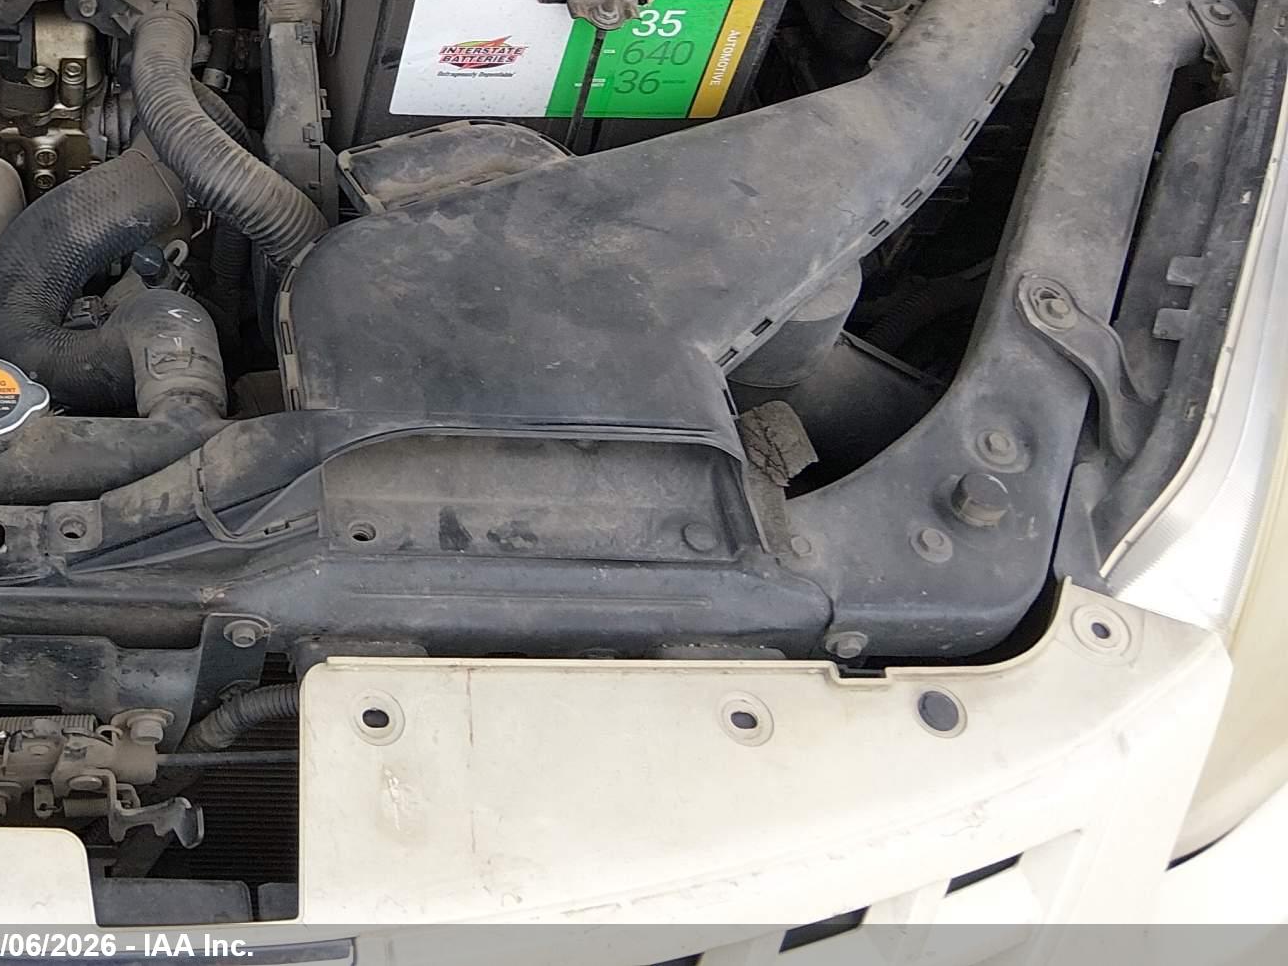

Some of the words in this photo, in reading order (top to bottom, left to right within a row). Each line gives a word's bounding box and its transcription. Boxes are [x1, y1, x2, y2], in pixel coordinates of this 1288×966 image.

[632, 9, 686, 37] 35
[439, 46, 526, 56] INTERSTATE
[439, 54, 518, 64] BATTERIES
[622, 40, 696, 66] 640
[709, 29, 741, 86] AUTOMOTIVE
[615, 69, 661, 95] 36
